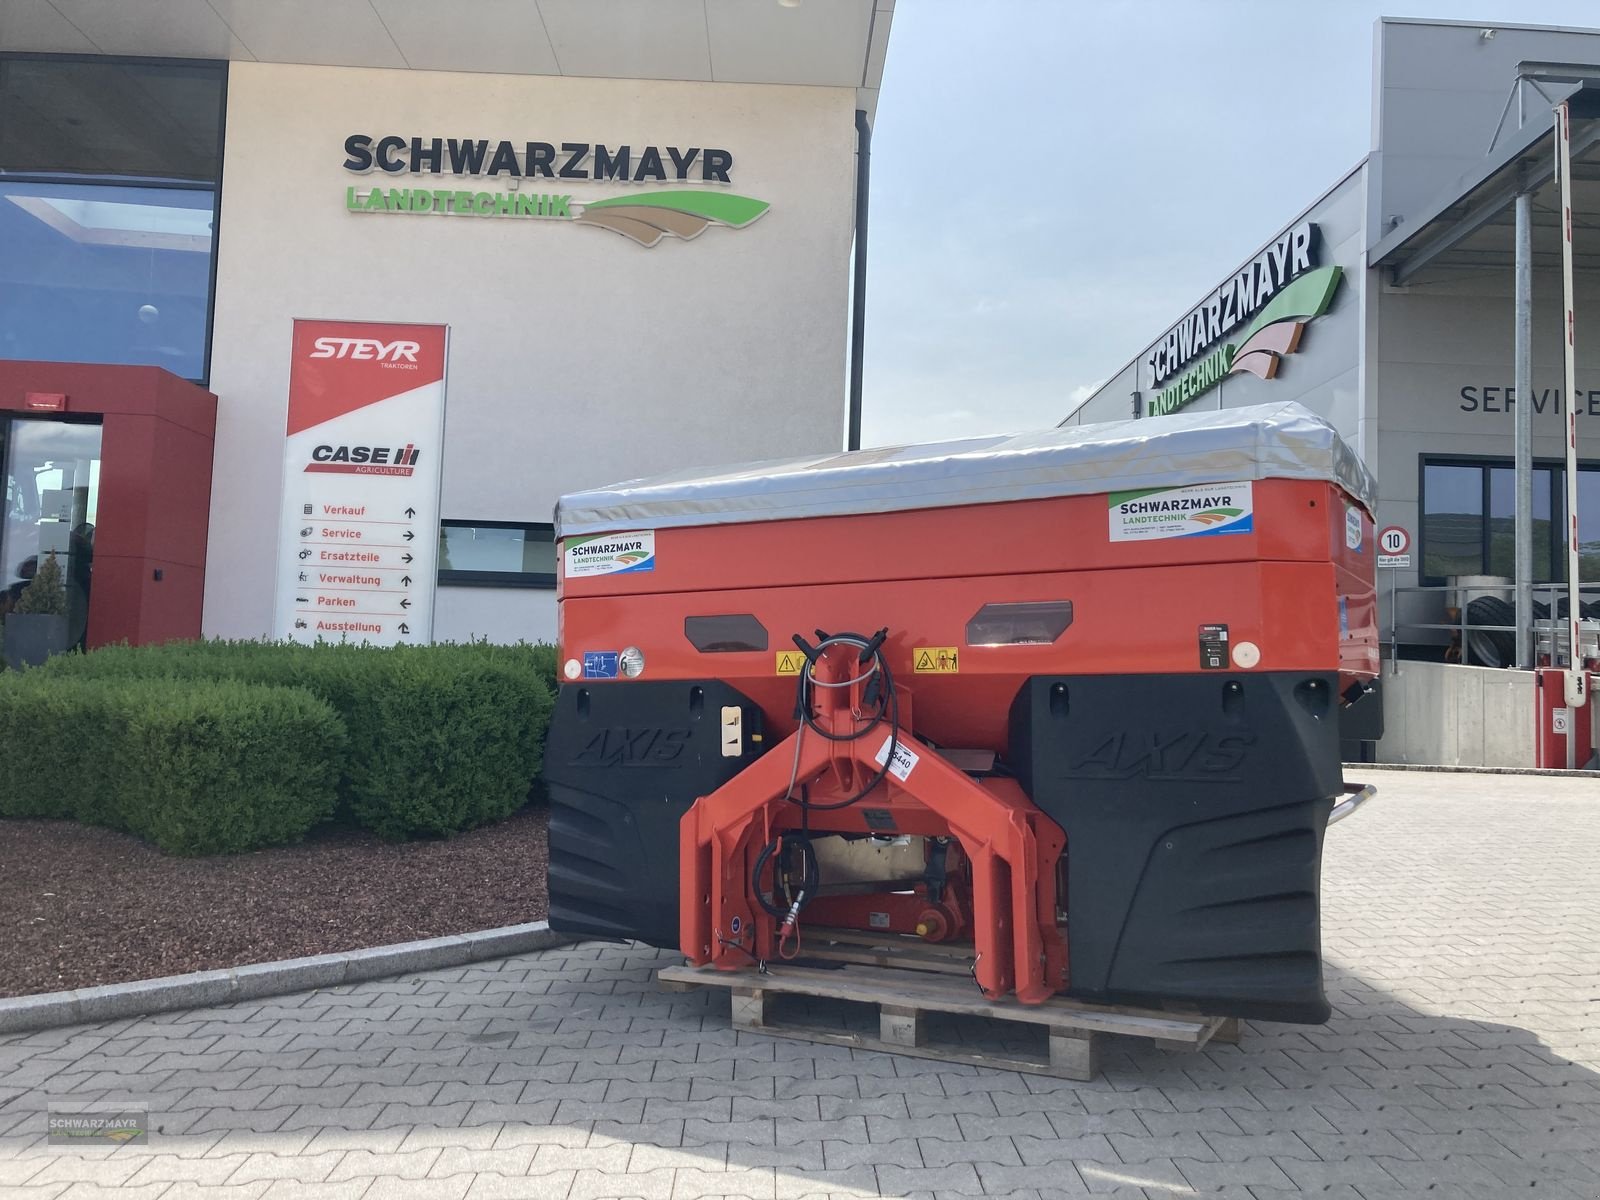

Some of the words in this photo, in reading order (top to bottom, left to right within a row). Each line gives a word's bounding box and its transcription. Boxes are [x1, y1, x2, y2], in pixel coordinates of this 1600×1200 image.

[343, 134, 734, 184] SCHWARZMAYR
[346, 186, 573, 218] LANDTECHNIK
[1147, 223, 1318, 389] SCHWARZMAYR
[309, 337, 420, 362] STEYR
[381, 362, 418, 370] TRAKTOREN
[1149, 344, 1235, 416] LANDTECHNIK
[312, 445, 390, 464] CASE
[355, 466, 410, 476] AGRICULTURE
[323, 505, 365, 516] Verkauf
[1120, 496, 1232, 515] SCHWARZMAYR
[1123, 513, 1187, 525] LANDTECHNIK
[322, 528, 361, 539] Service
[572, 541, 642, 556] SCHWARZMAYR
[1386, 534, 1400, 549] 10
[320, 551, 380, 562] Ersatzteile
[573, 555, 614, 564] LANDTECHNIK
[319, 573, 381, 587] Verwaltung
[318, 596, 356, 607] Parken
[316, 620, 382, 634] Ausstellung
[573, 728, 693, 762] AXIS
[1070, 731, 1258, 773] AXIS
